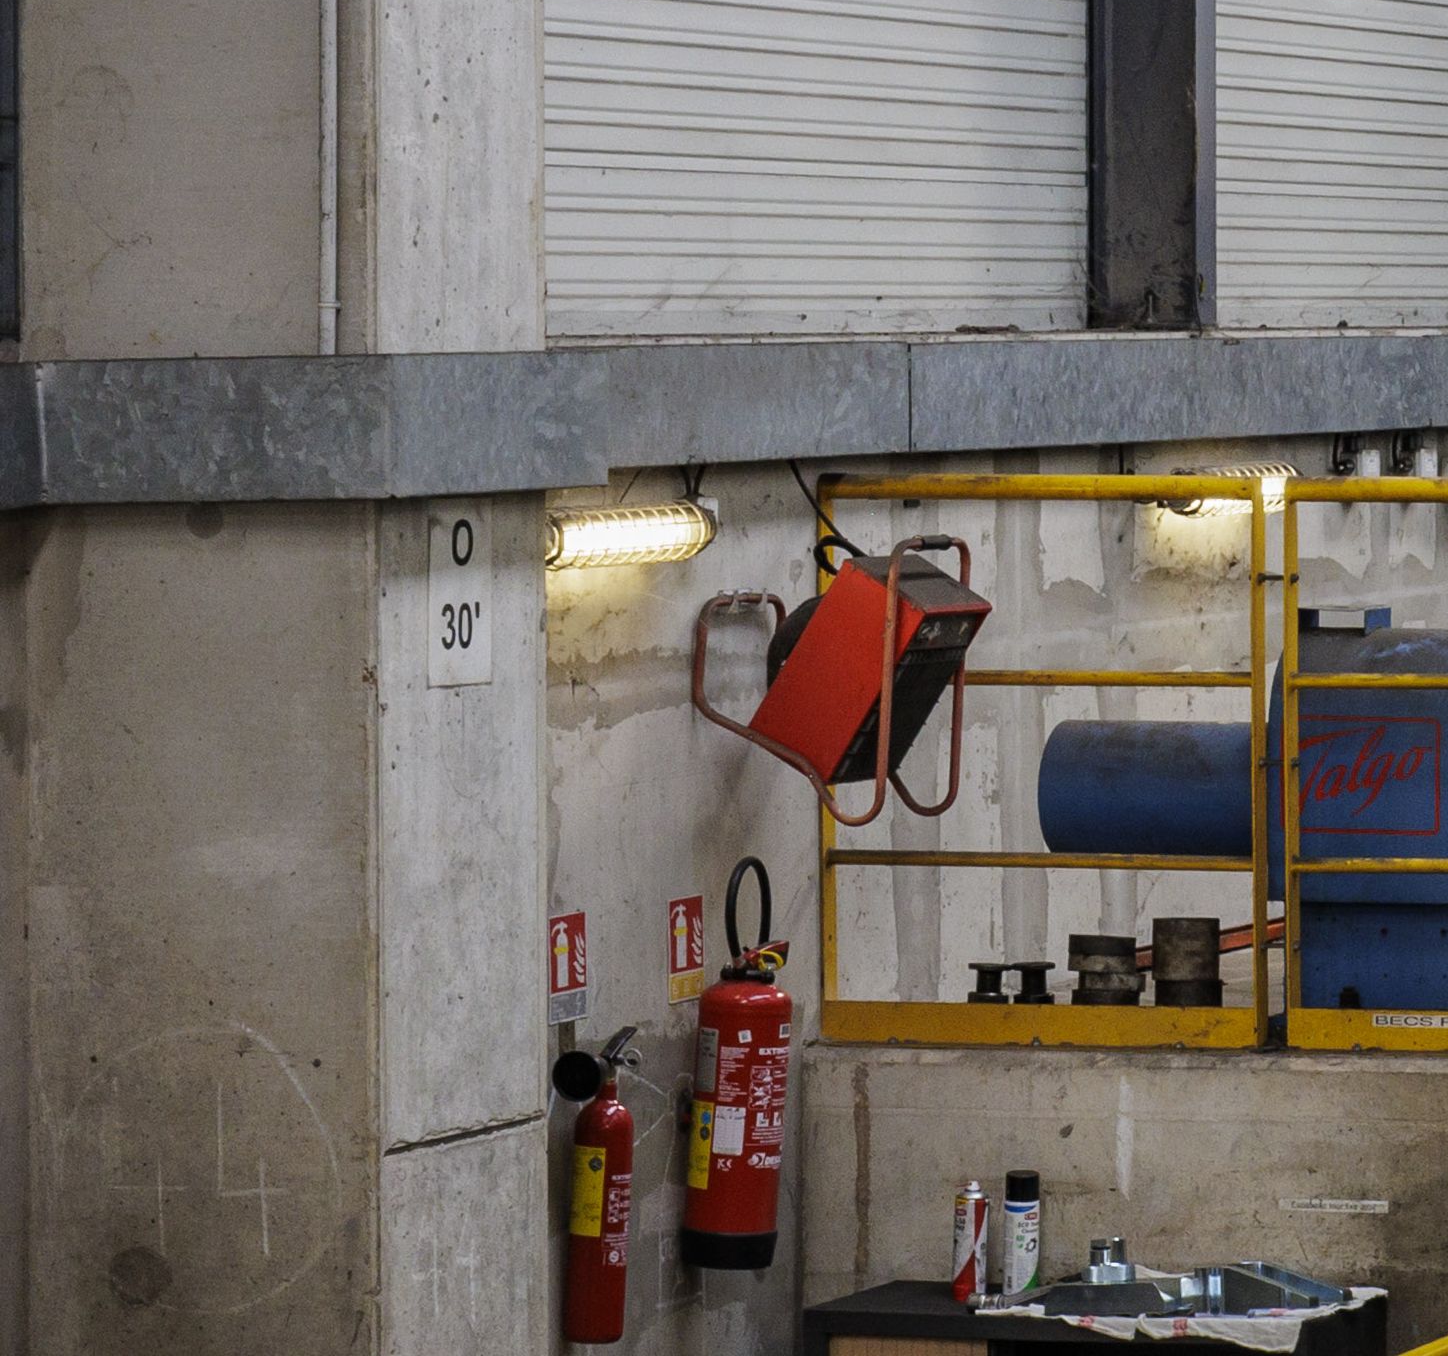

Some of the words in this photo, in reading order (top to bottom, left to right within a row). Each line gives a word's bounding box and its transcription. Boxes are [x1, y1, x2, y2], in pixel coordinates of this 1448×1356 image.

[441, 601, 480, 651] 30'
[1299, 724, 1433, 817] Talgo
[1375, 1015, 1433, 1027] BECS
